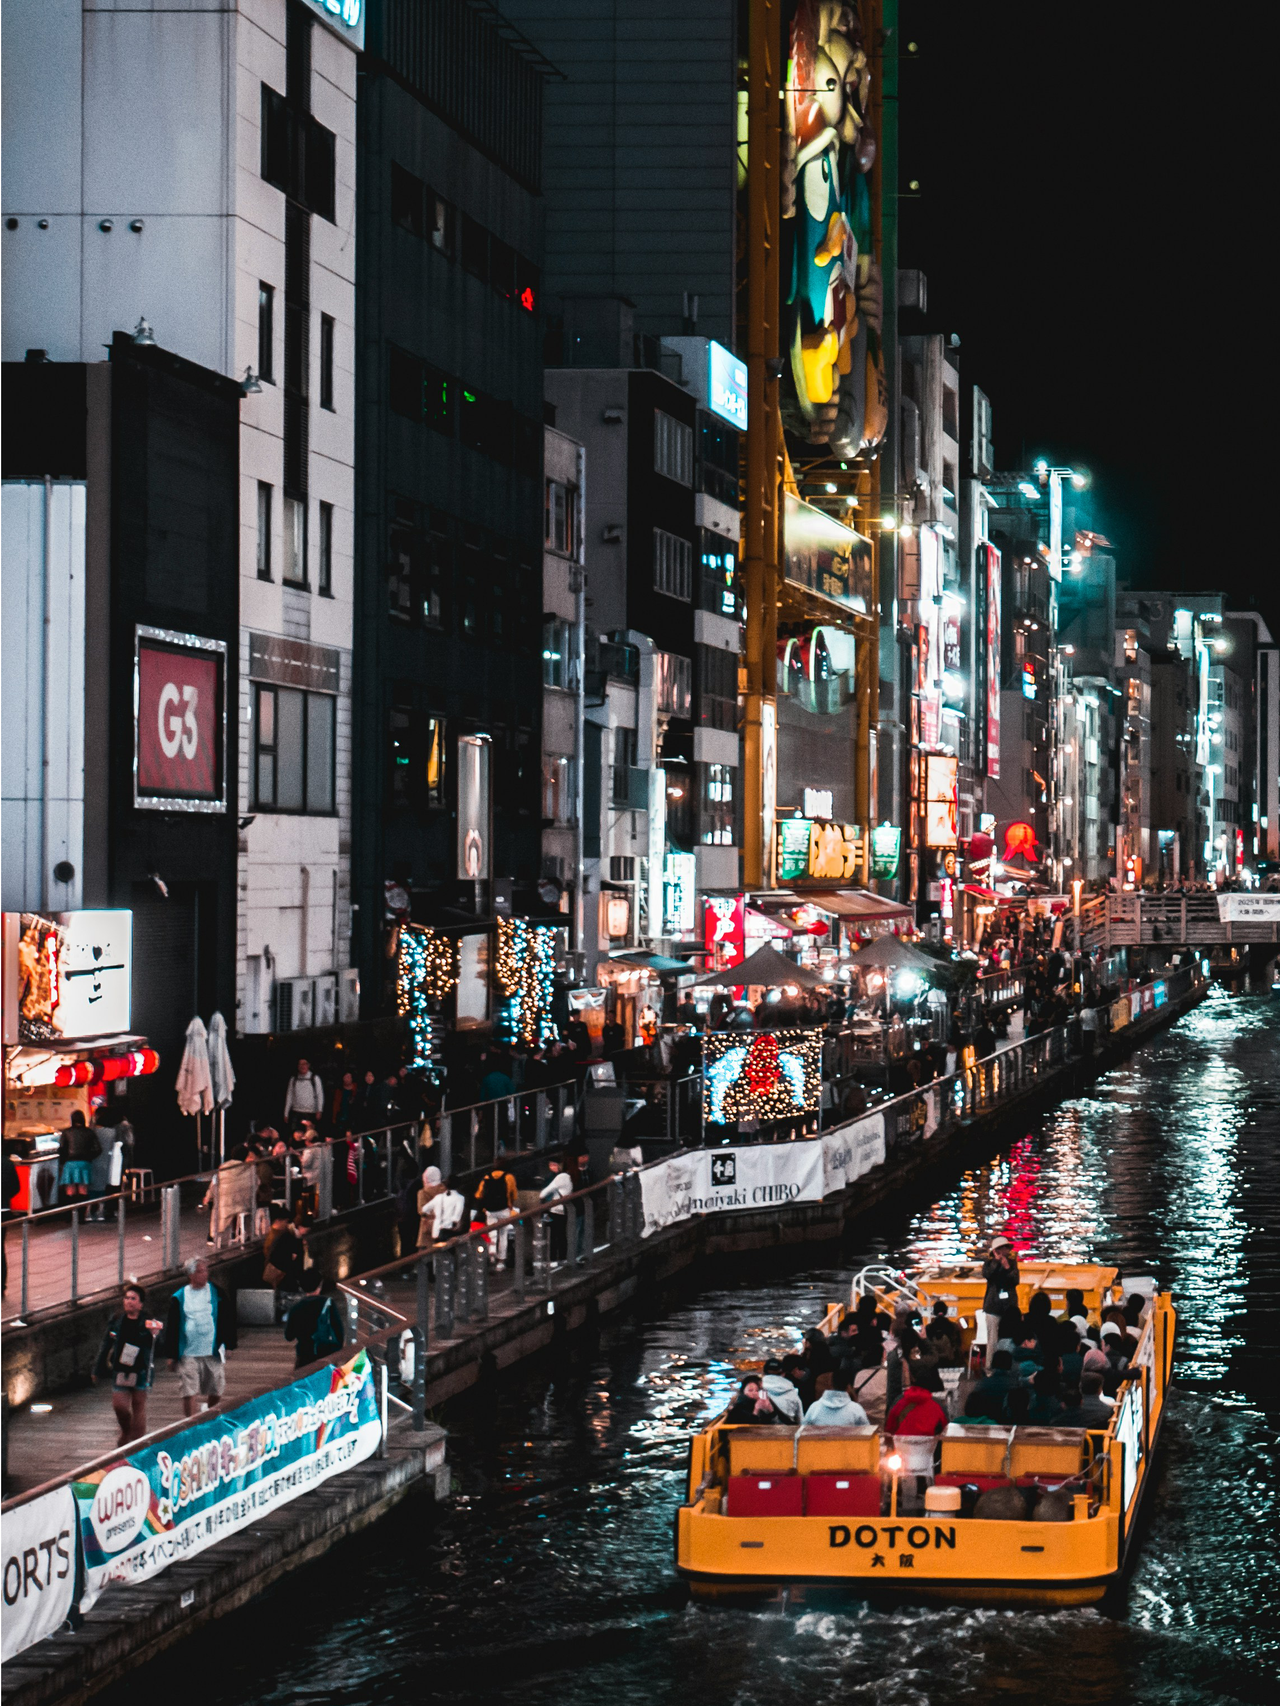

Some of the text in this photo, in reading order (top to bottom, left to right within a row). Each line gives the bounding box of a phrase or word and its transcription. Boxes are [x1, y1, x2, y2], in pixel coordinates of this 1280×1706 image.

[158, 682, 198, 760] G3
[752, 1183, 801, 1204] CHIBO
[97, 1478, 144, 1524] WAON
[105, 1516, 136, 1541] presents
[828, 1524, 957, 1550] DOTON
